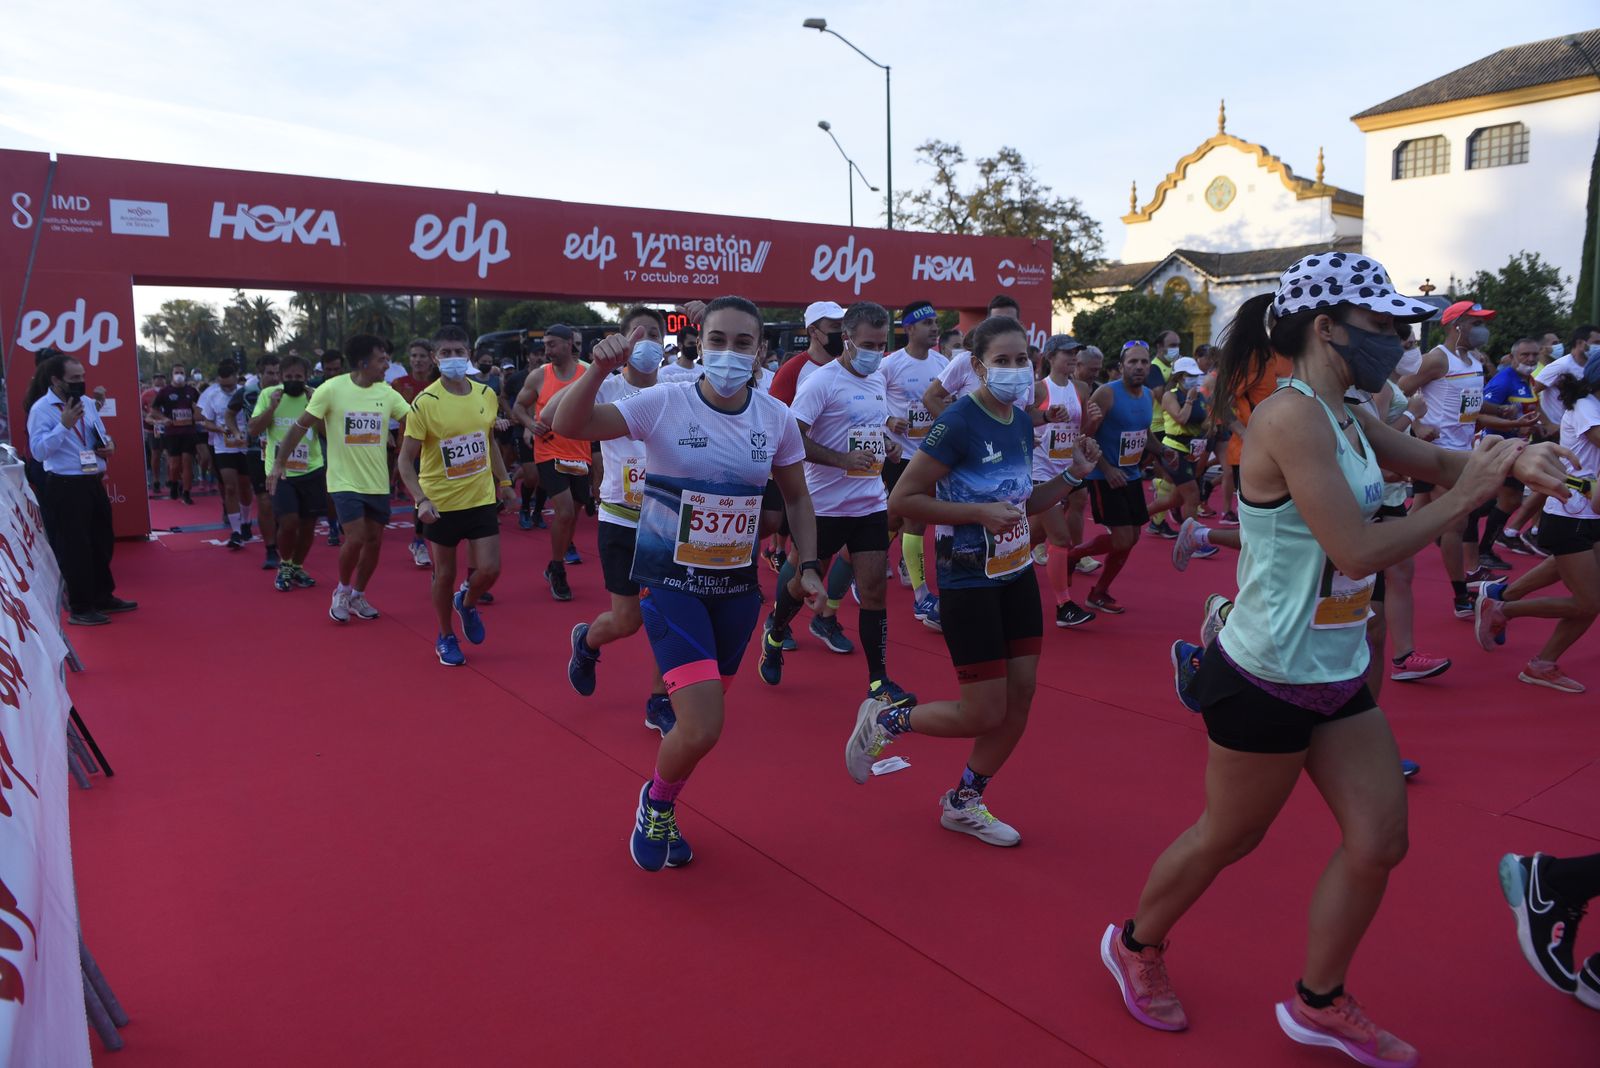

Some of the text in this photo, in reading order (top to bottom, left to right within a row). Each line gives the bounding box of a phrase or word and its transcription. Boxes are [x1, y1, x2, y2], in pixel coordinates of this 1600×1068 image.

[52, 194, 91, 211] IMD
[43, 216, 103, 227] nstituto Municipal
[61, 224, 94, 233] Deportes
[209, 201, 342, 247] HOKA
[409, 202, 511, 279] edp
[563, 226, 617, 270] edp
[659, 233, 751, 255] maratón
[684, 251, 752, 273] sevilla
[811, 235, 876, 295] edp
[912, 255, 975, 282] HOKA
[623, 270, 720, 285] 17 octubre 2021
[16, 298, 123, 367] edp
[1026, 322, 1047, 354] dp
[349, 419, 376, 429] 5078
[926, 423, 946, 447] OTSO
[448, 441, 480, 460] 5210
[751, 449, 768, 460] OTSO
[690, 493, 758, 508] edp edp edp
[690, 509, 748, 535] 5370
[663, 577, 750, 596] FOR WHAT YOU WANT
[697, 574, 731, 587] FIGHT
